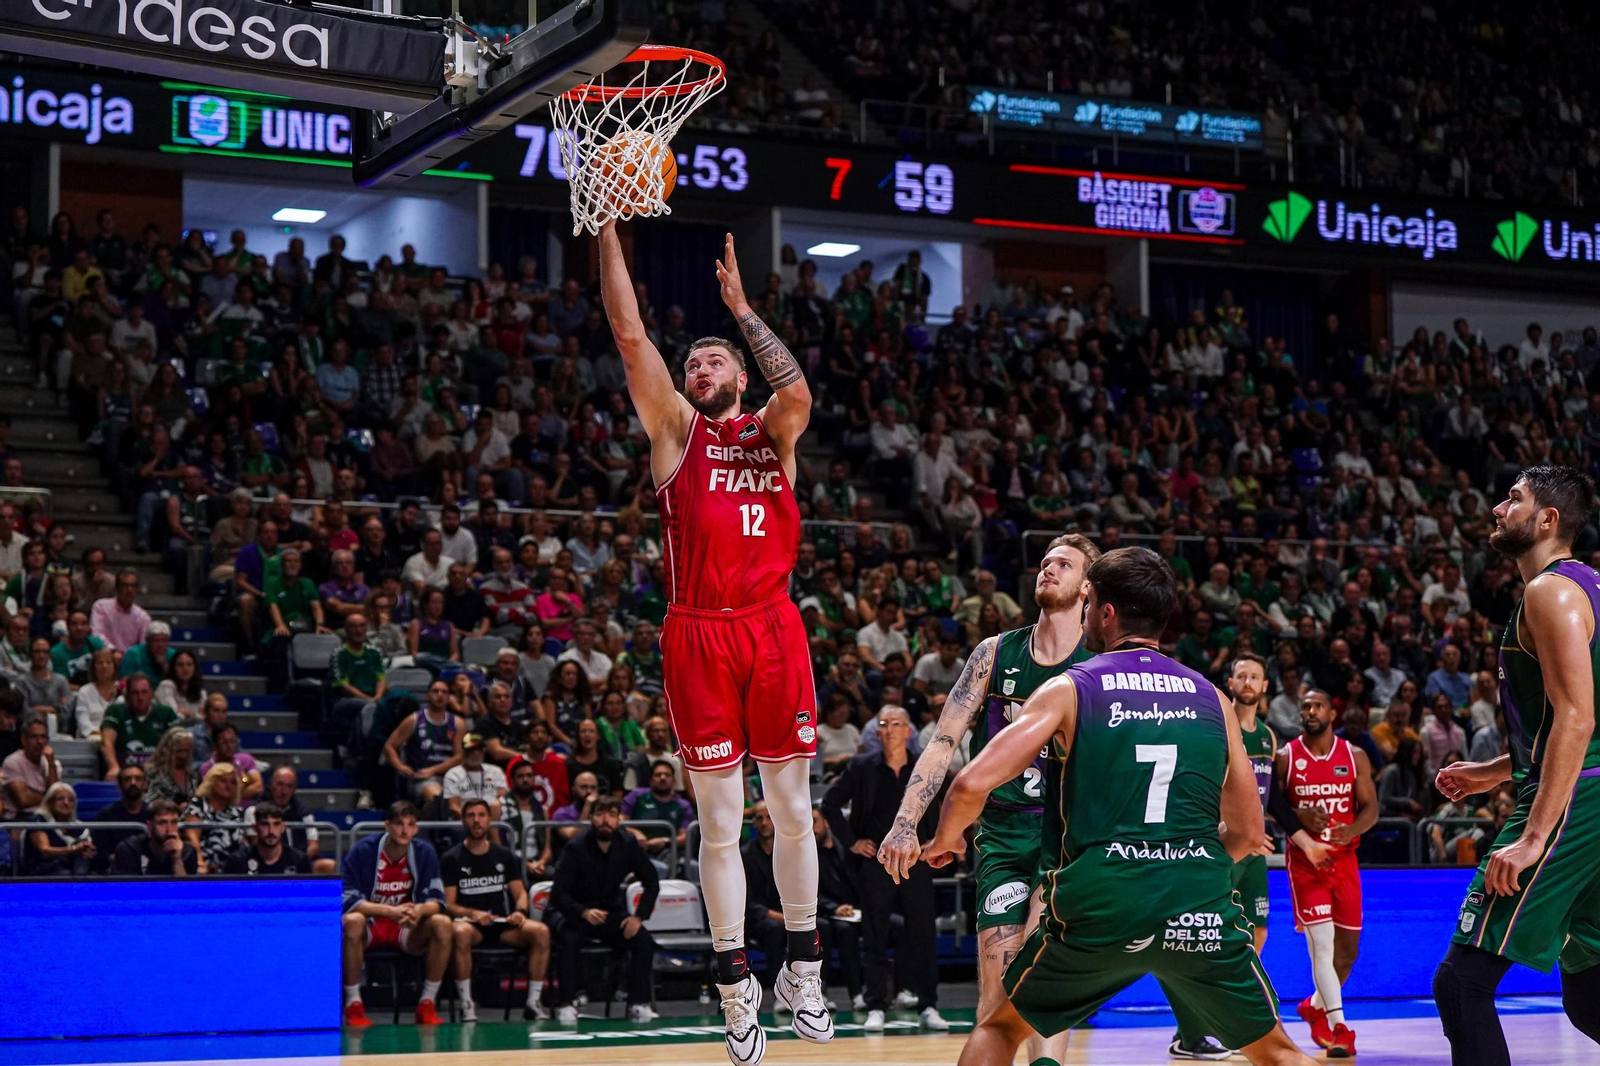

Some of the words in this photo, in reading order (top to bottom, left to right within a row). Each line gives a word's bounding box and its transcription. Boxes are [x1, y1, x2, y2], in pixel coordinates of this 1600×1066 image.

[261, 109, 352, 154] UNIC
[825, 158, 852, 200] 7
[894, 161, 954, 214] 59
[1078, 171, 1172, 207] BÀSQUET
[1095, 203, 1171, 233] GIRONA
[1316, 200, 1458, 260] Unicaja
[706, 444, 778, 465] GIRNA
[708, 468, 783, 492] FIATC
[739, 504, 766, 537] 12
[1101, 672, 1197, 694] BARREIRO
[695, 740, 732, 761] YOSOY
[1023, 767, 1041, 797] 2
[1135, 744, 1178, 823] 7
[1294, 783, 1352, 796] GIRONA
[1105, 838, 1216, 860] Andalucía
[459, 874, 505, 888] GIRONA
[987, 885, 1029, 912] famadesa
[1162, 940, 1222, 953] MÁLAGA
[1165, 929, 1195, 940] DEL
[1198, 929, 1223, 940] SOL
